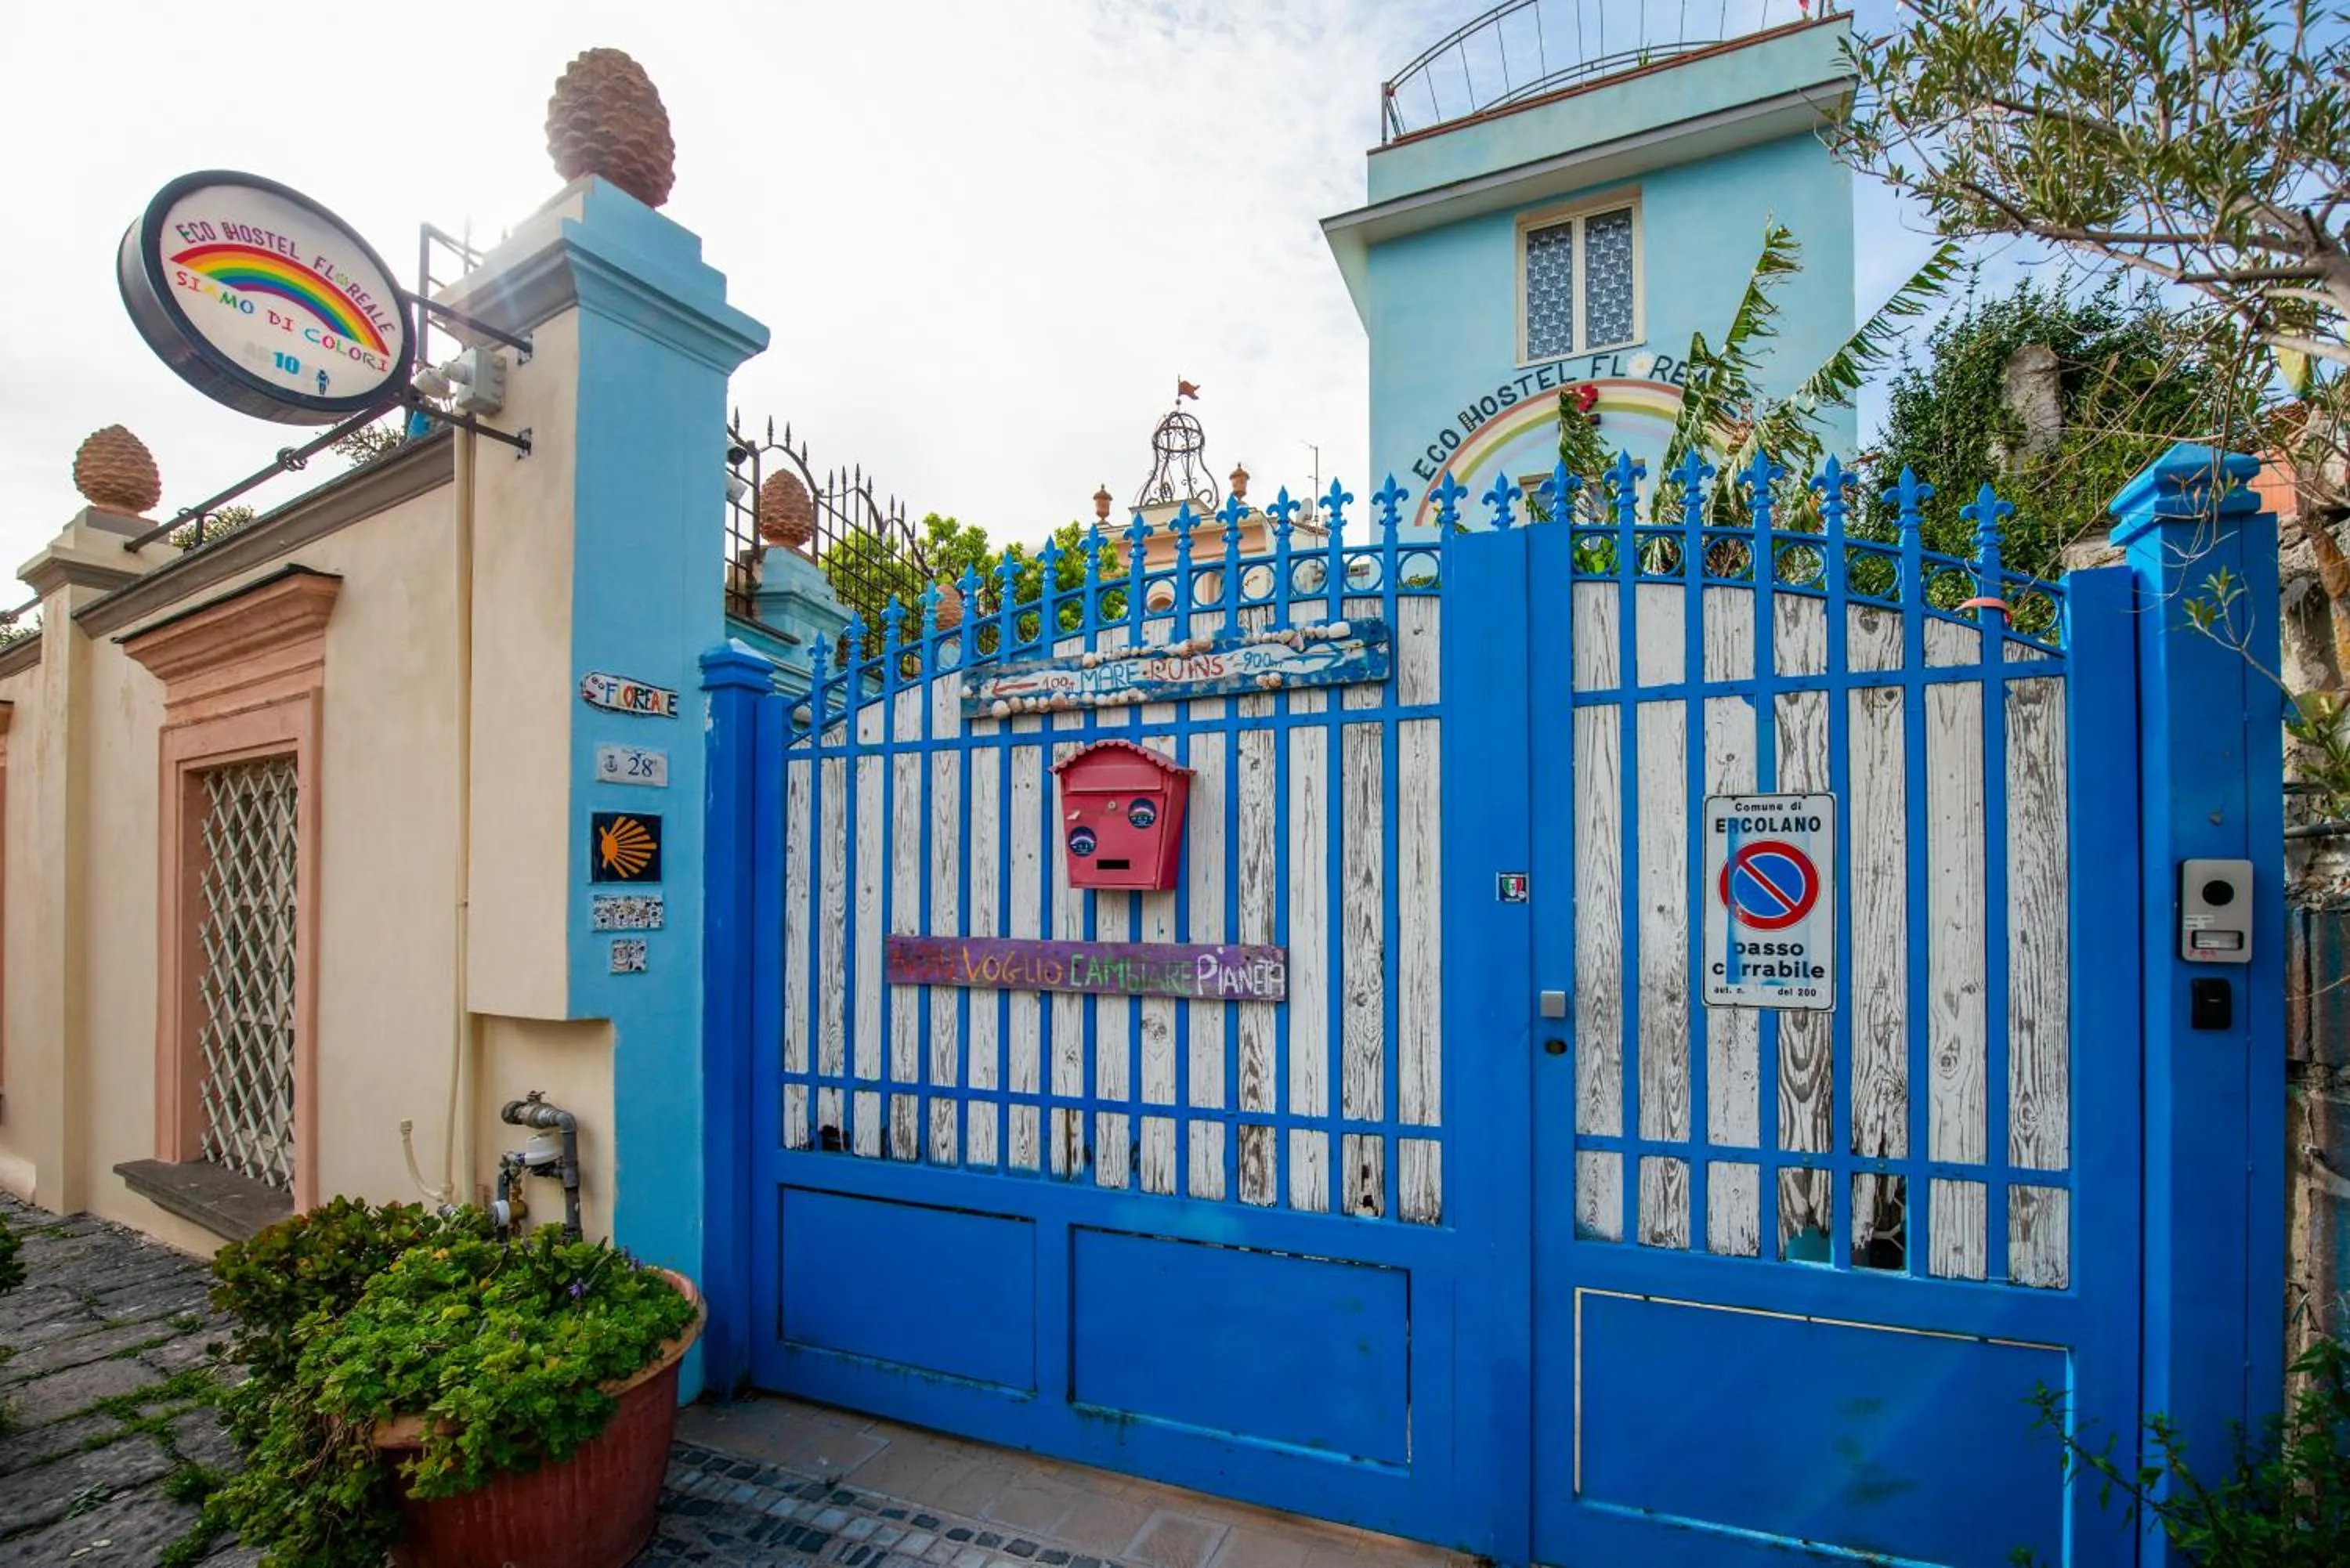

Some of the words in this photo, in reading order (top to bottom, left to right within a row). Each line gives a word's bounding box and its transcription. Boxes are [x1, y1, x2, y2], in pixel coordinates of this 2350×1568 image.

[175, 221, 216, 244] ECO
[175, 270, 256, 314] SIAMO
[267, 309, 294, 332] DI
[303, 328, 389, 372] COLORI
[273, 352, 300, 374] 10
[1412, 428, 1462, 481] ECO
[1458, 363, 1577, 433] HOSTEL
[1080, 660, 1139, 692] MARE
[1150, 656, 1224, 681] RUINS
[627, 757, 653, 778] 28
[1734, 803, 1783, 811] Comune
[1791, 801, 1802, 811] di
[1716, 816, 1821, 833] ERCOLANO
[963, 946, 1062, 985] VOGLIO
[1712, 960, 1825, 978] crrabile
